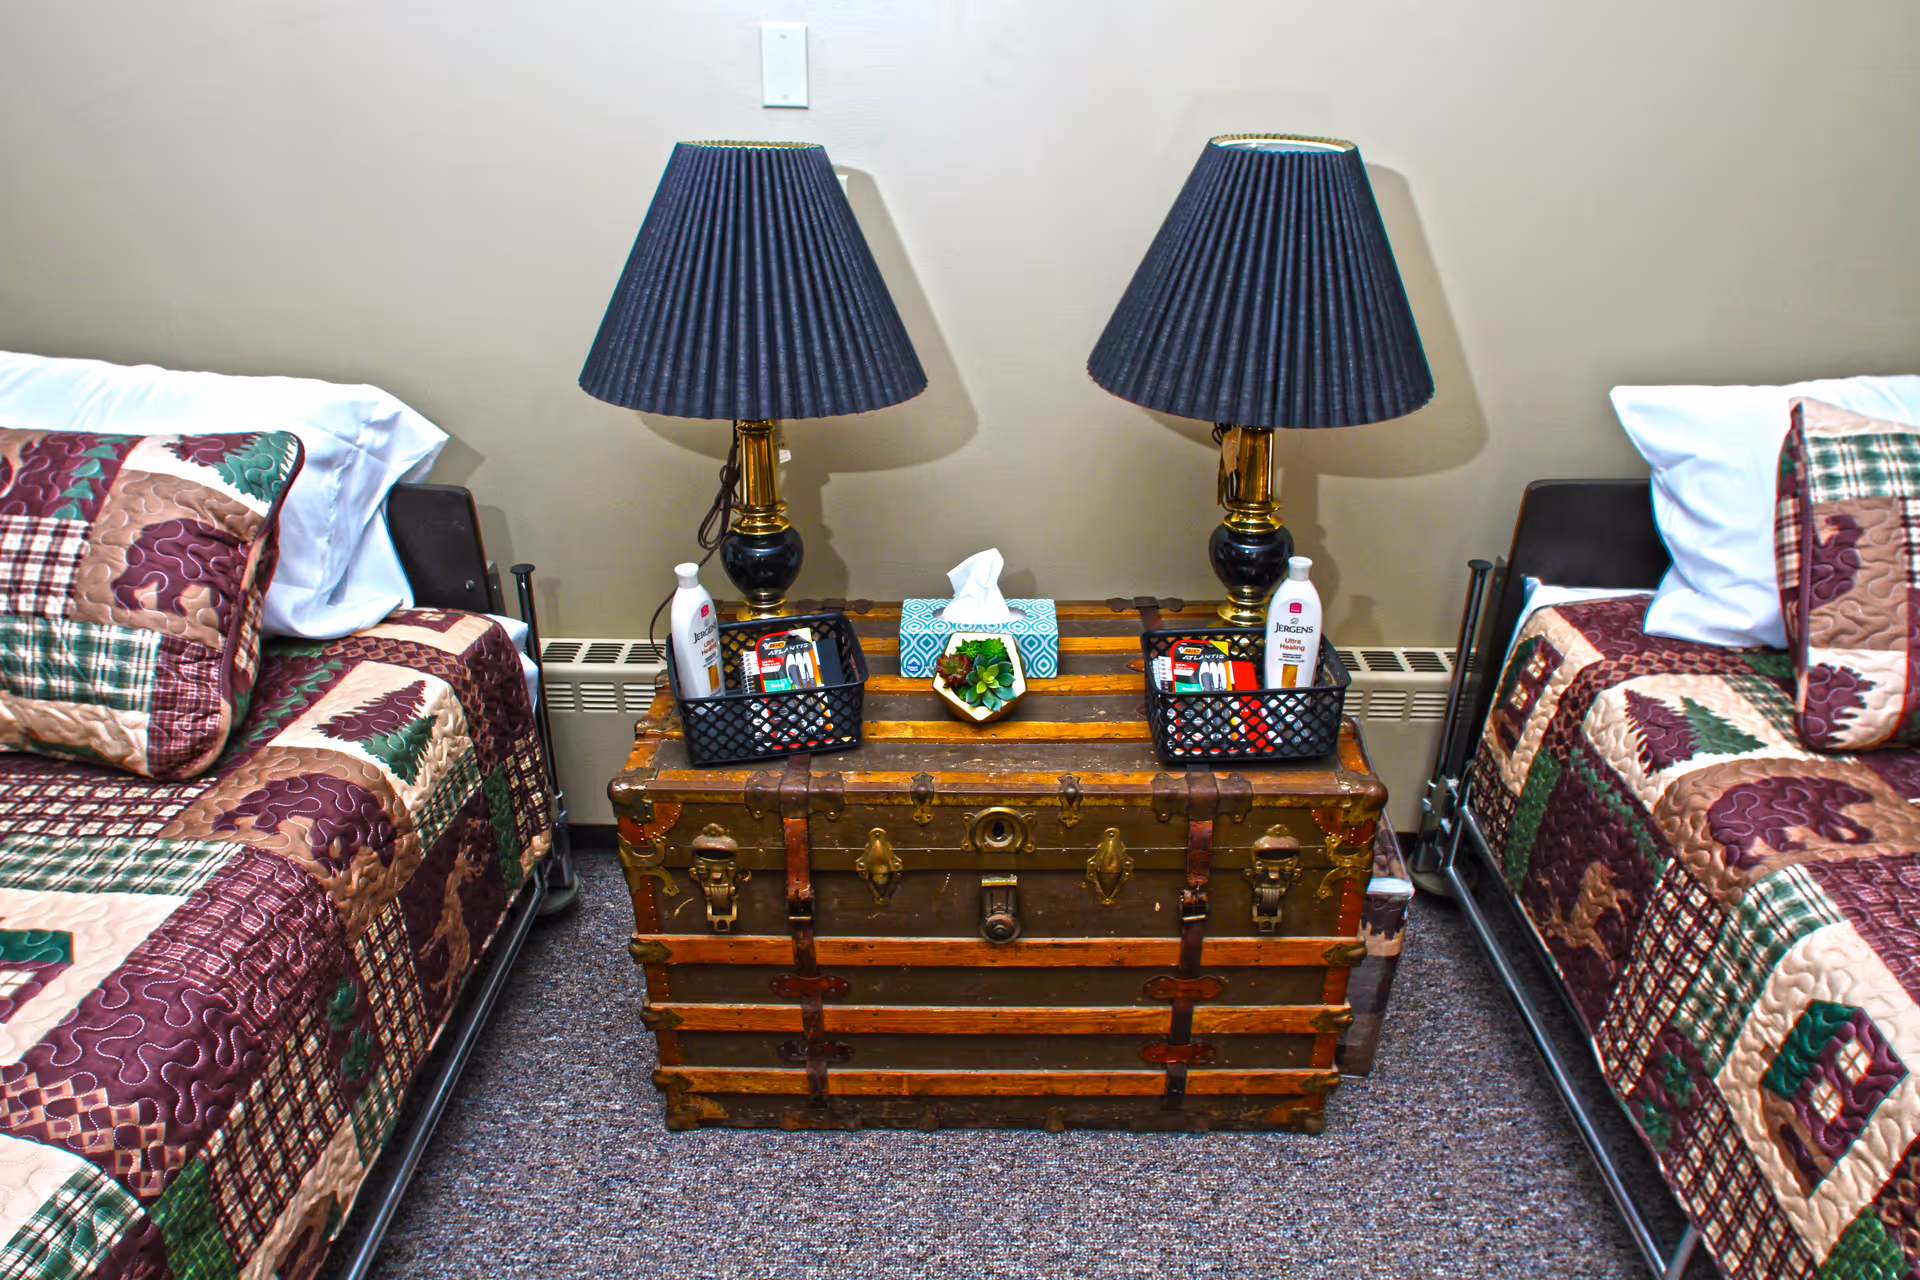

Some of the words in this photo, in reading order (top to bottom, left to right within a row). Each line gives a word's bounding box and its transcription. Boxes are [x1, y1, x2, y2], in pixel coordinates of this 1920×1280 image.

[1274, 622, 1313, 633] JERGENS
[768, 642, 809, 656] ATLANTIS
[769, 641, 785, 649] BIC
[1280, 643, 1305, 652] Healing
[1184, 647, 1201, 655] BIC
[1182, 653, 1225, 661] ATLANTIS
